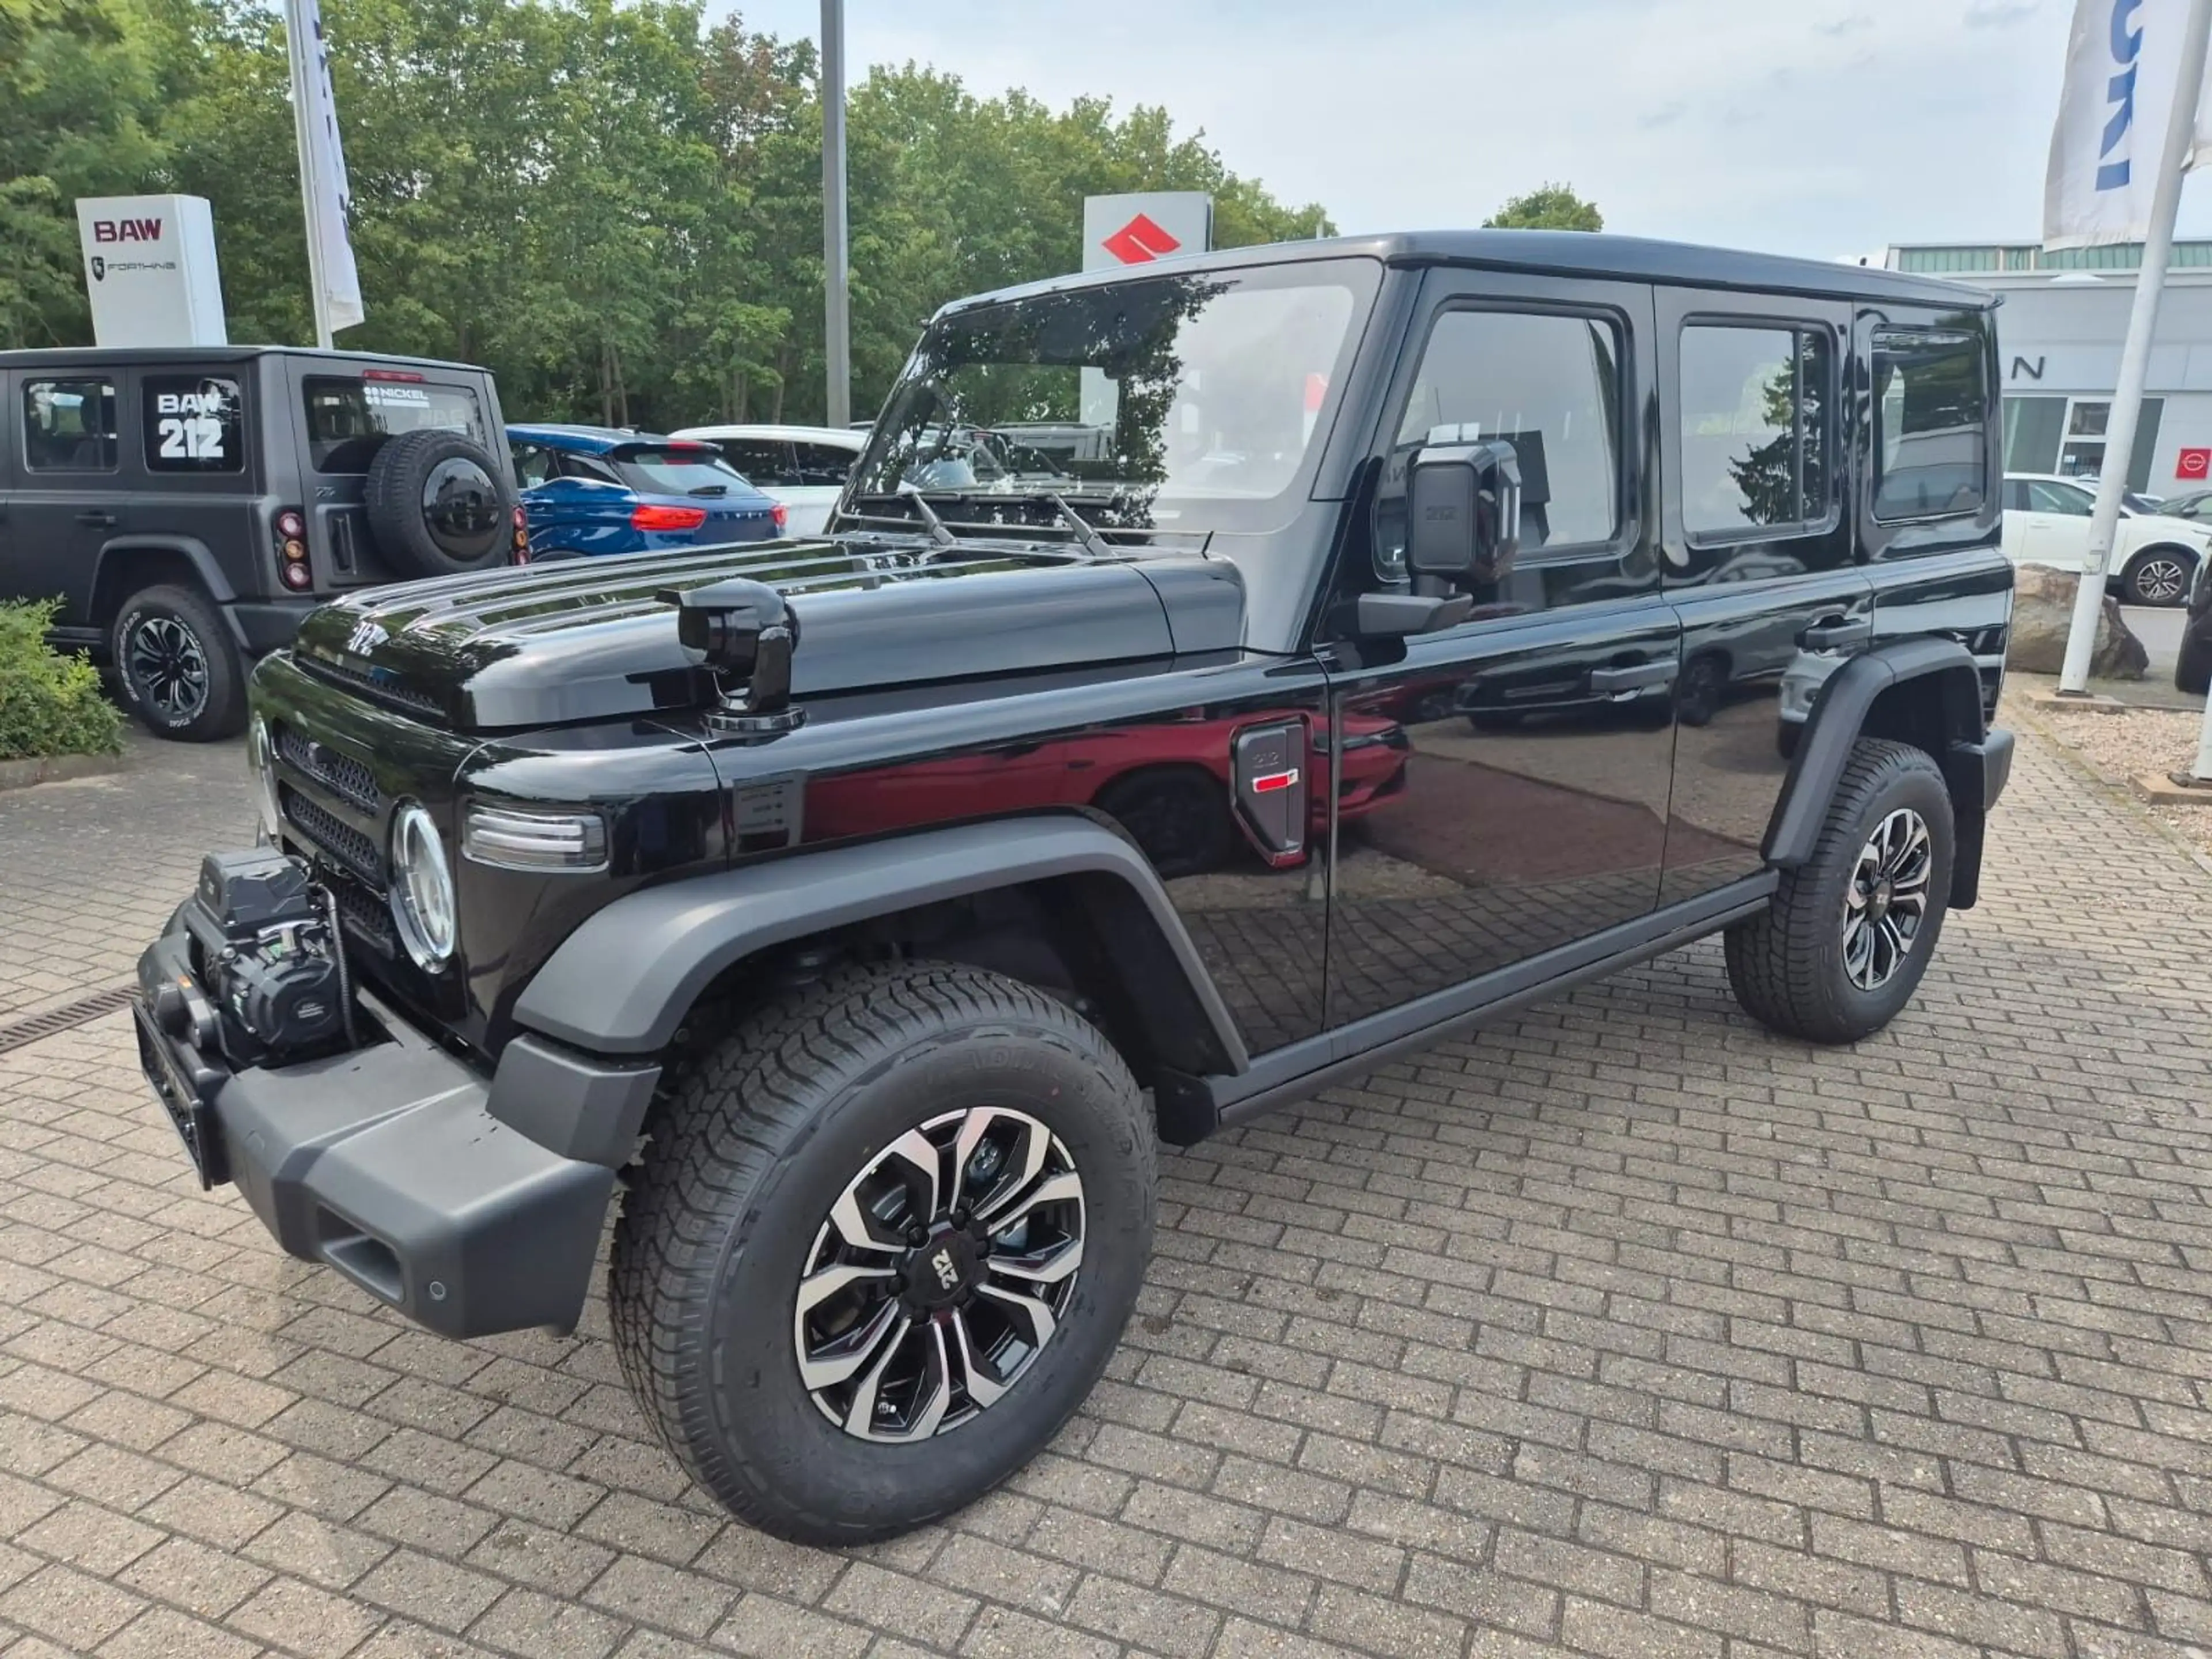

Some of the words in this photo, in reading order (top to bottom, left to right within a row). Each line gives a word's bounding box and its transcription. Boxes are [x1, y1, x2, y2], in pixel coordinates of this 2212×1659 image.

[94, 218, 162, 243] BAW
[158, 393, 221, 414] BAW
[380, 388, 429, 400] NICKEL
[159, 418, 224, 458] 212
[931, 1248, 959, 1290] 212
